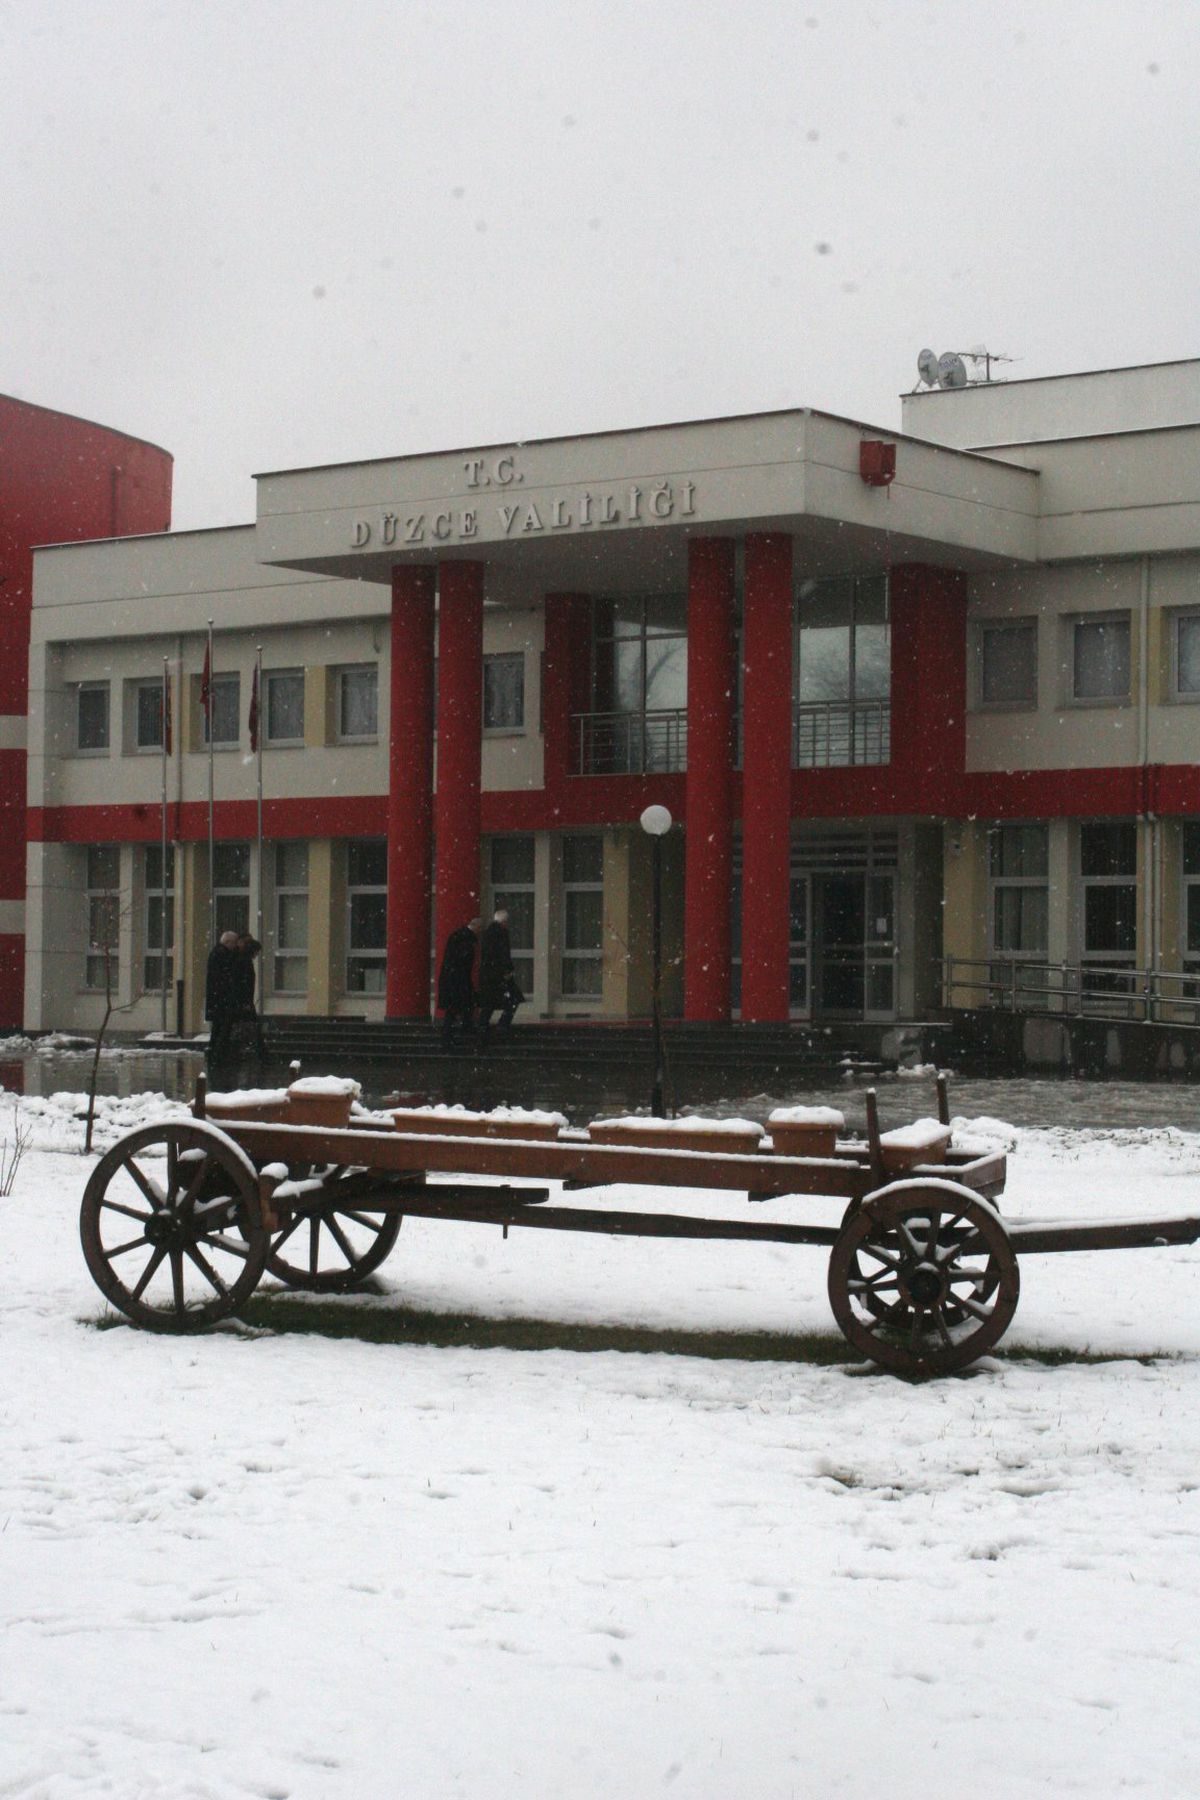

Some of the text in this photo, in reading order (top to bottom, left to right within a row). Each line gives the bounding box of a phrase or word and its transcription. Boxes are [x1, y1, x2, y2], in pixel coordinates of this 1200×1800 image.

[464, 456, 524, 488] T.C.
[350, 481, 696, 548] DÜZCE VALİLİĞİ
